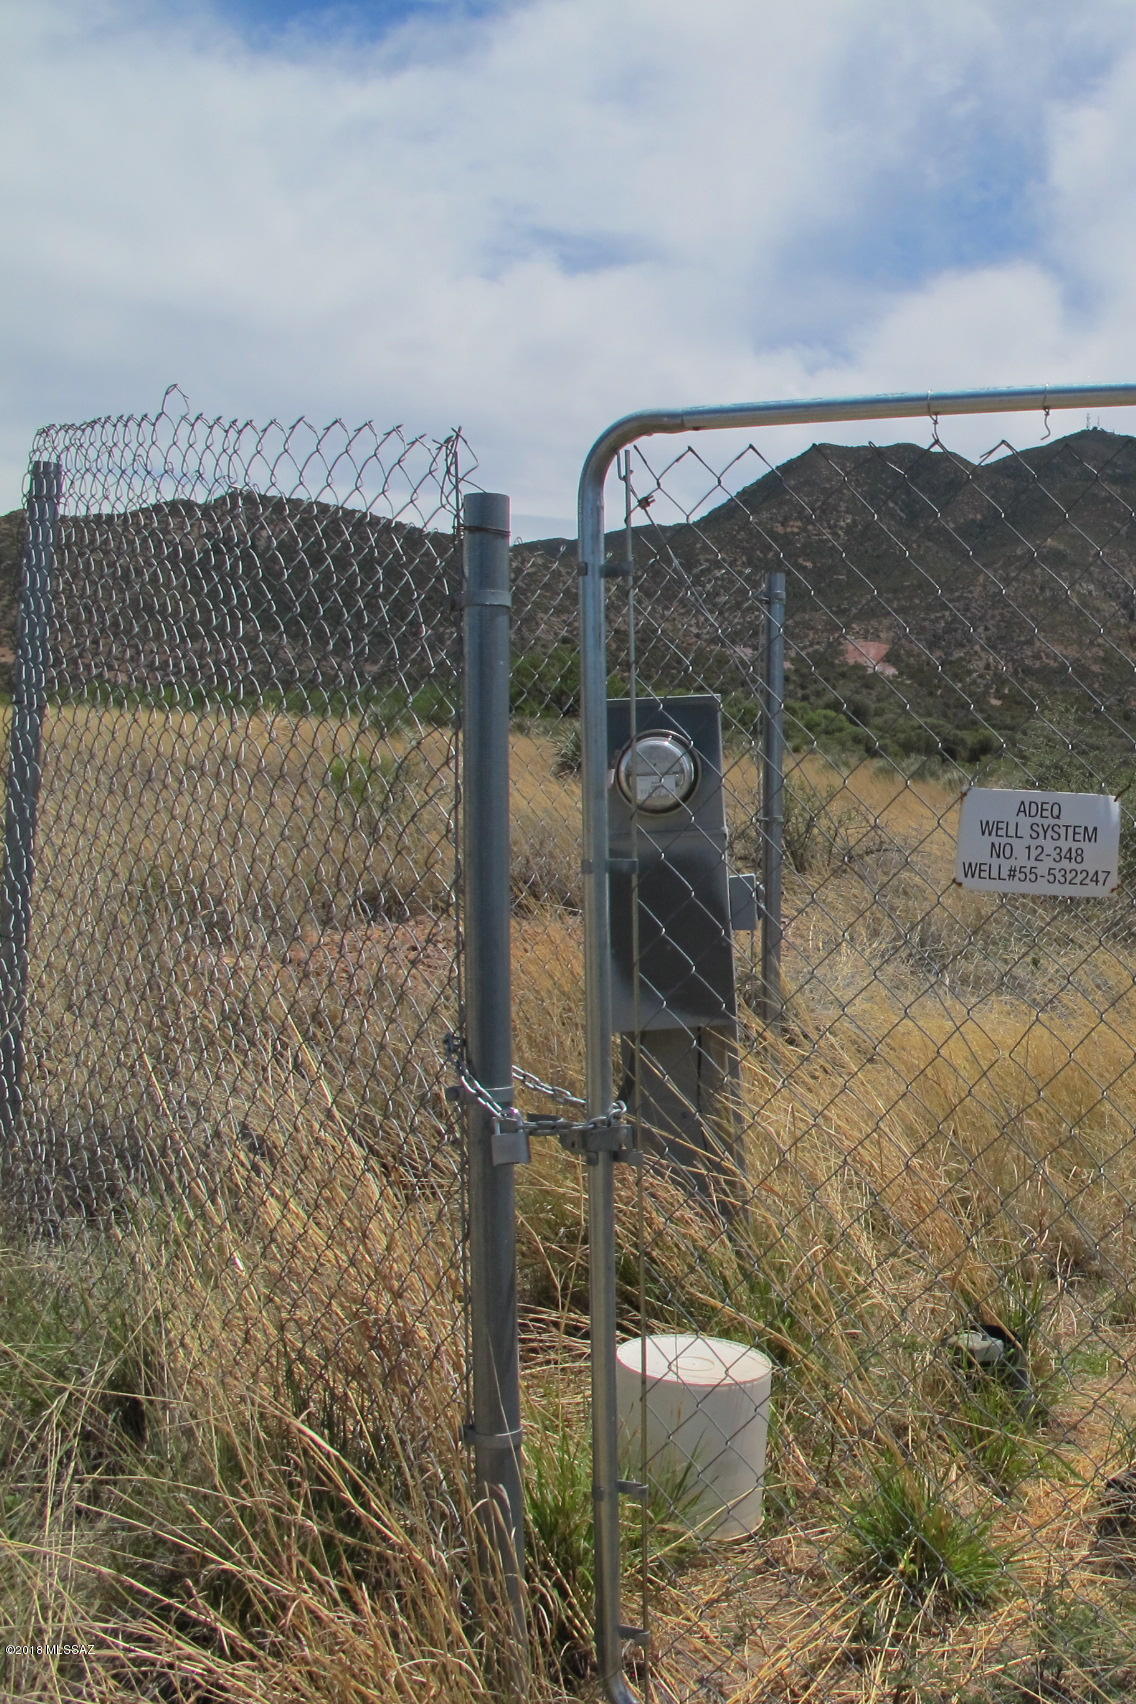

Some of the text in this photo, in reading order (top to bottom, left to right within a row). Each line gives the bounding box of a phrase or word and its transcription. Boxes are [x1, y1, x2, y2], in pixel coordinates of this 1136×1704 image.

[1016, 801, 1061, 819] ADEQ
[980, 820, 1098, 843] WELL SYSTEM
[990, 842, 1084, 864] NO. 12-348
[962, 862, 1111, 886] WELL#55-532247
